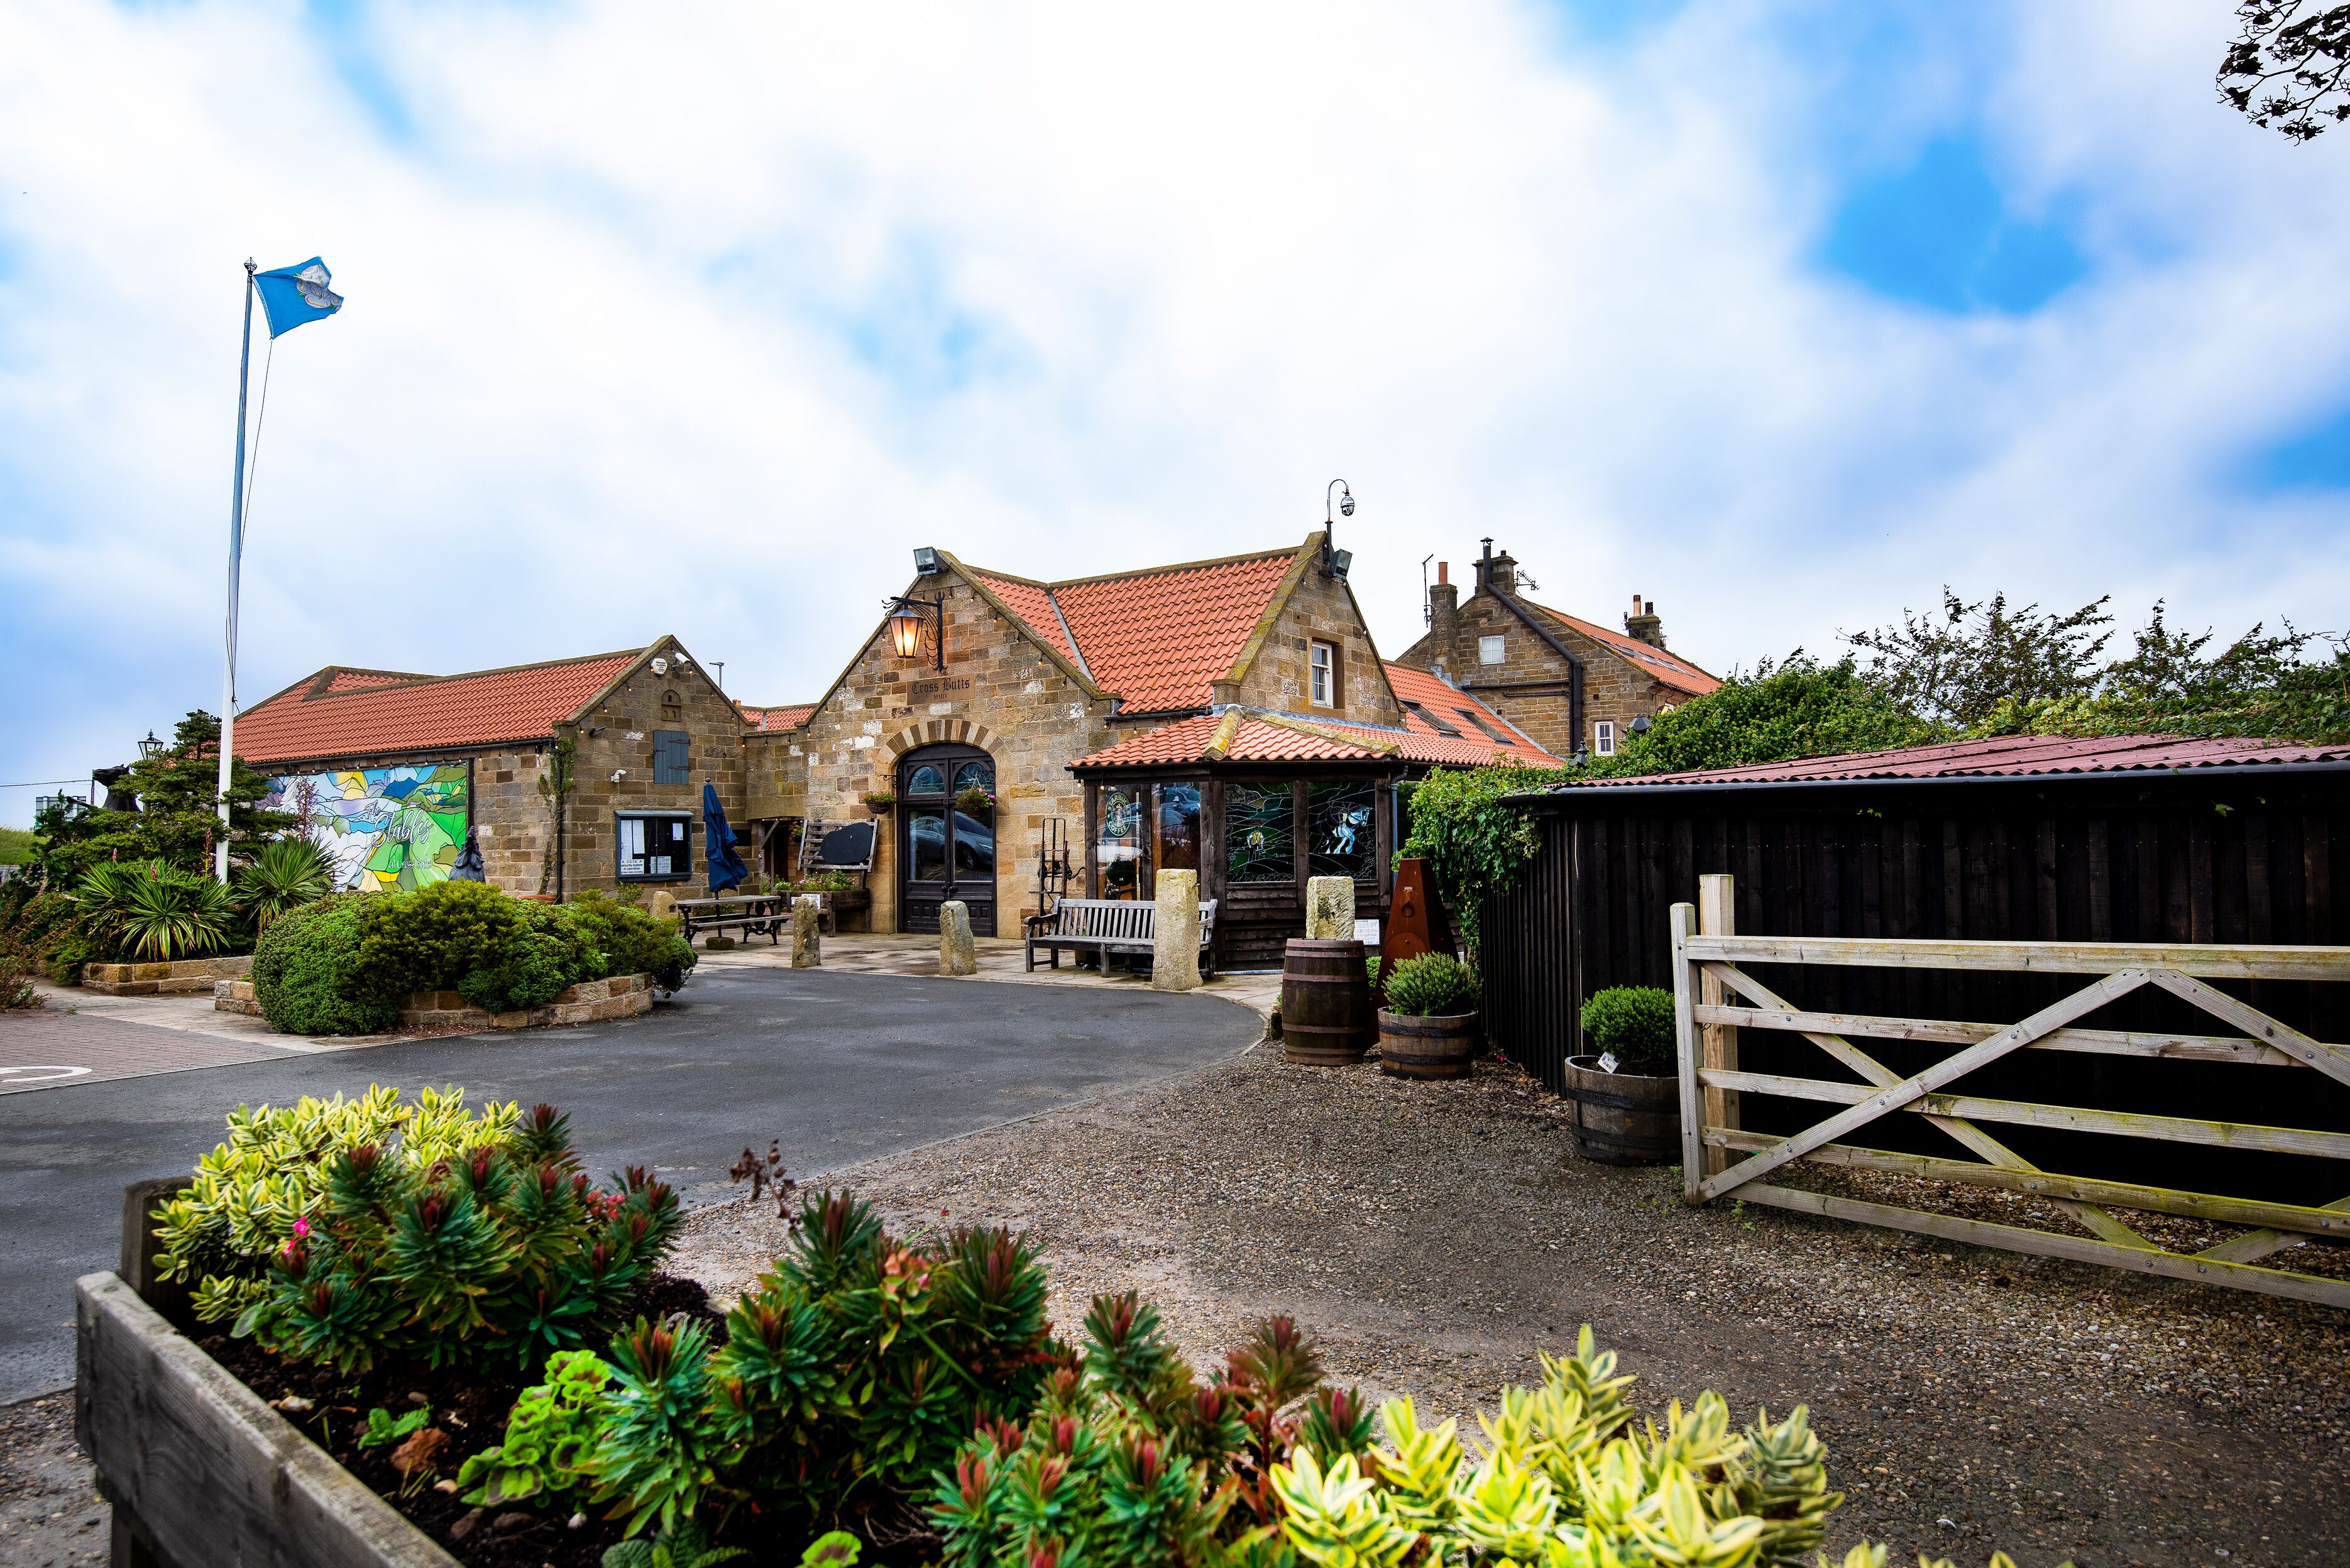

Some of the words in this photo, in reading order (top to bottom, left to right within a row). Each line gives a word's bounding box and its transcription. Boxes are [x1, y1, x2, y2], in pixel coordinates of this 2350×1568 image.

[912, 681, 939, 694] Cross
[942, 677, 970, 693] Butts
[365, 799, 381, 816] The
[1107, 794, 1131, 815] STARBUCKS
[371, 808, 434, 847] Stables
[1109, 821, 1127, 834] COFFEE
[389, 855, 396, 869] at
[397, 857, 415, 869] Cross
